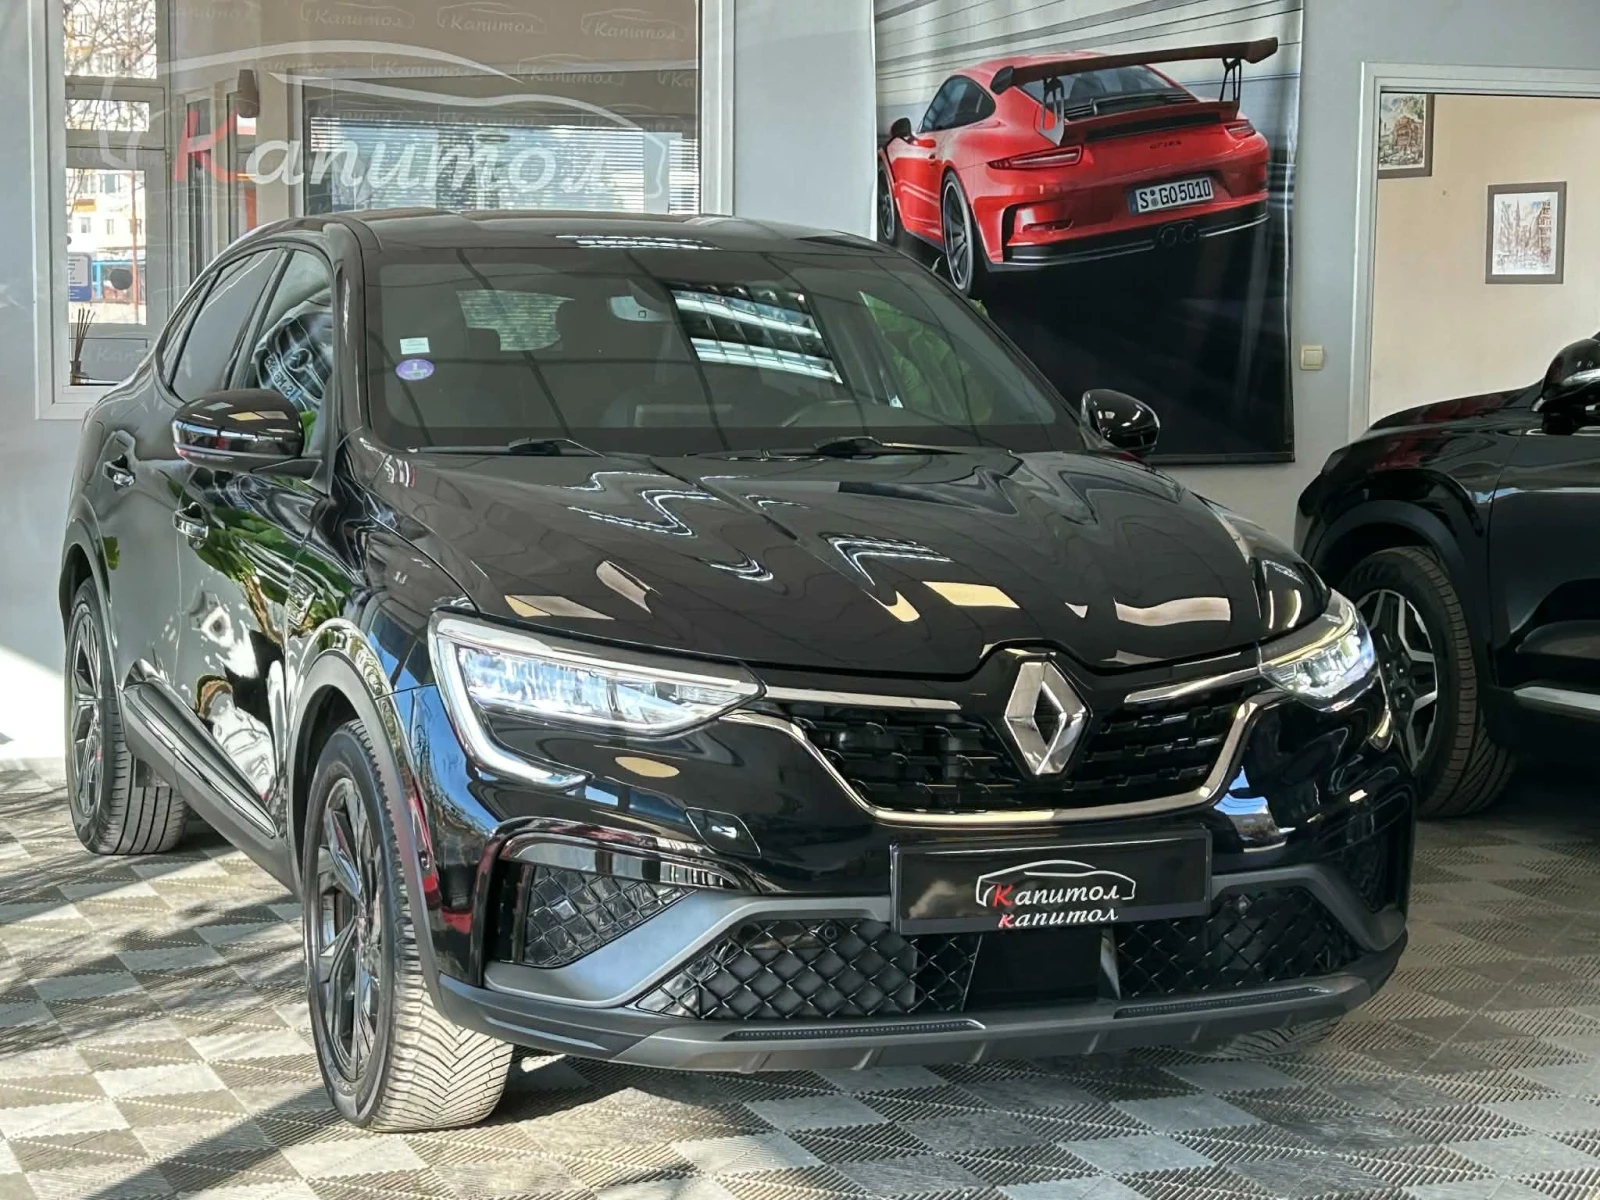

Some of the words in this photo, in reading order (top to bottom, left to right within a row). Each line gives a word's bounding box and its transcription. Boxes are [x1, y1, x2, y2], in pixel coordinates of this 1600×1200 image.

[449, 13, 538, 33] Капитол
[593, 20, 678, 41] Капитол
[173, 107, 613, 195] Капитол
[991, 883, 1120, 908] Капитол
